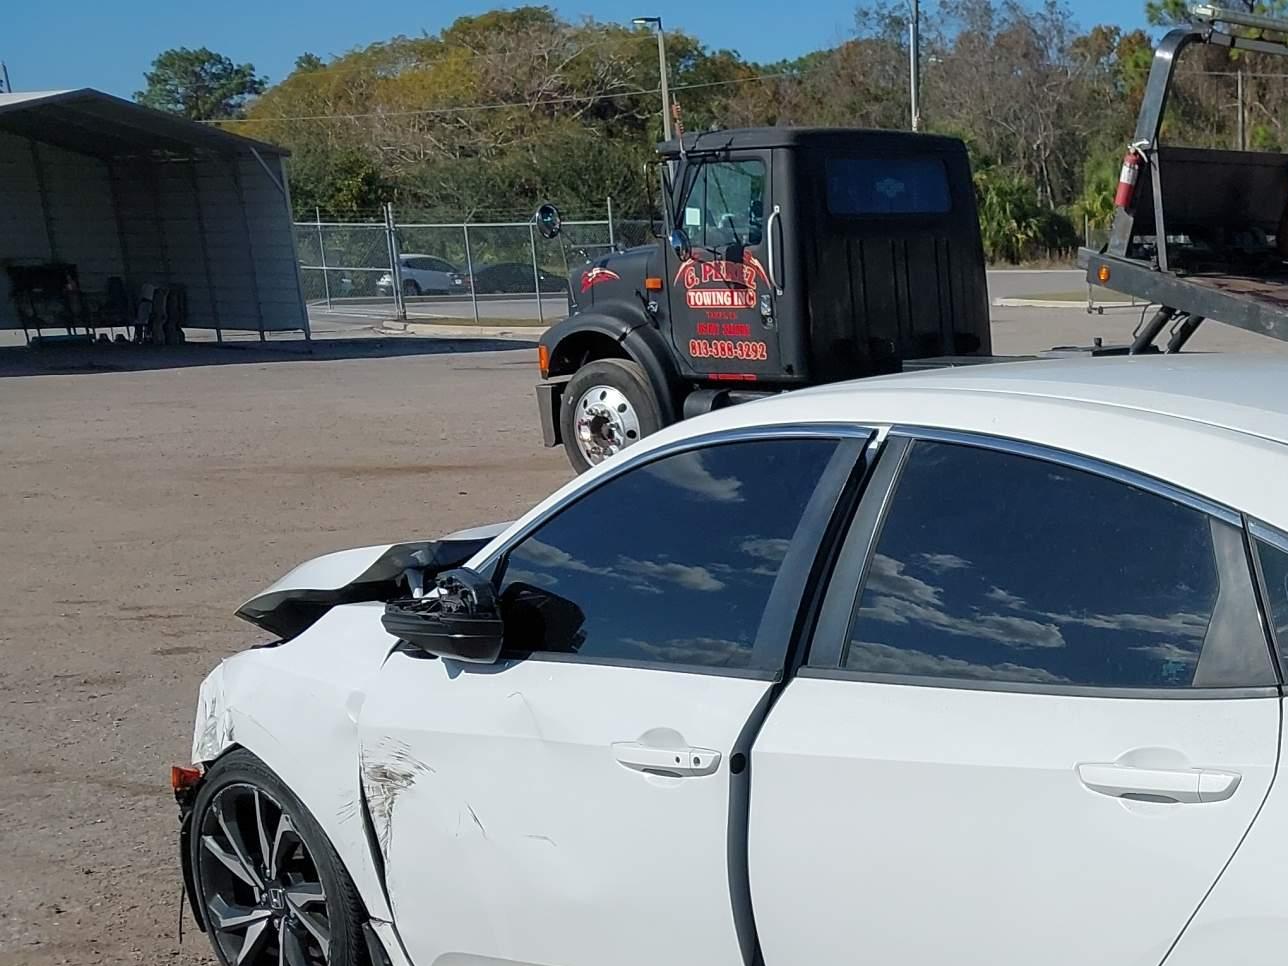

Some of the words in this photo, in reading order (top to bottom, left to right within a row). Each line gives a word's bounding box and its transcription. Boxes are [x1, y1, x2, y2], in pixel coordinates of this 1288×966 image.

[702, 261, 756, 289] PEZ
[688, 291, 732, 305] TOWING
[733, 291, 755, 305] INC
[690, 339, 767, 359] 813-388-3292
